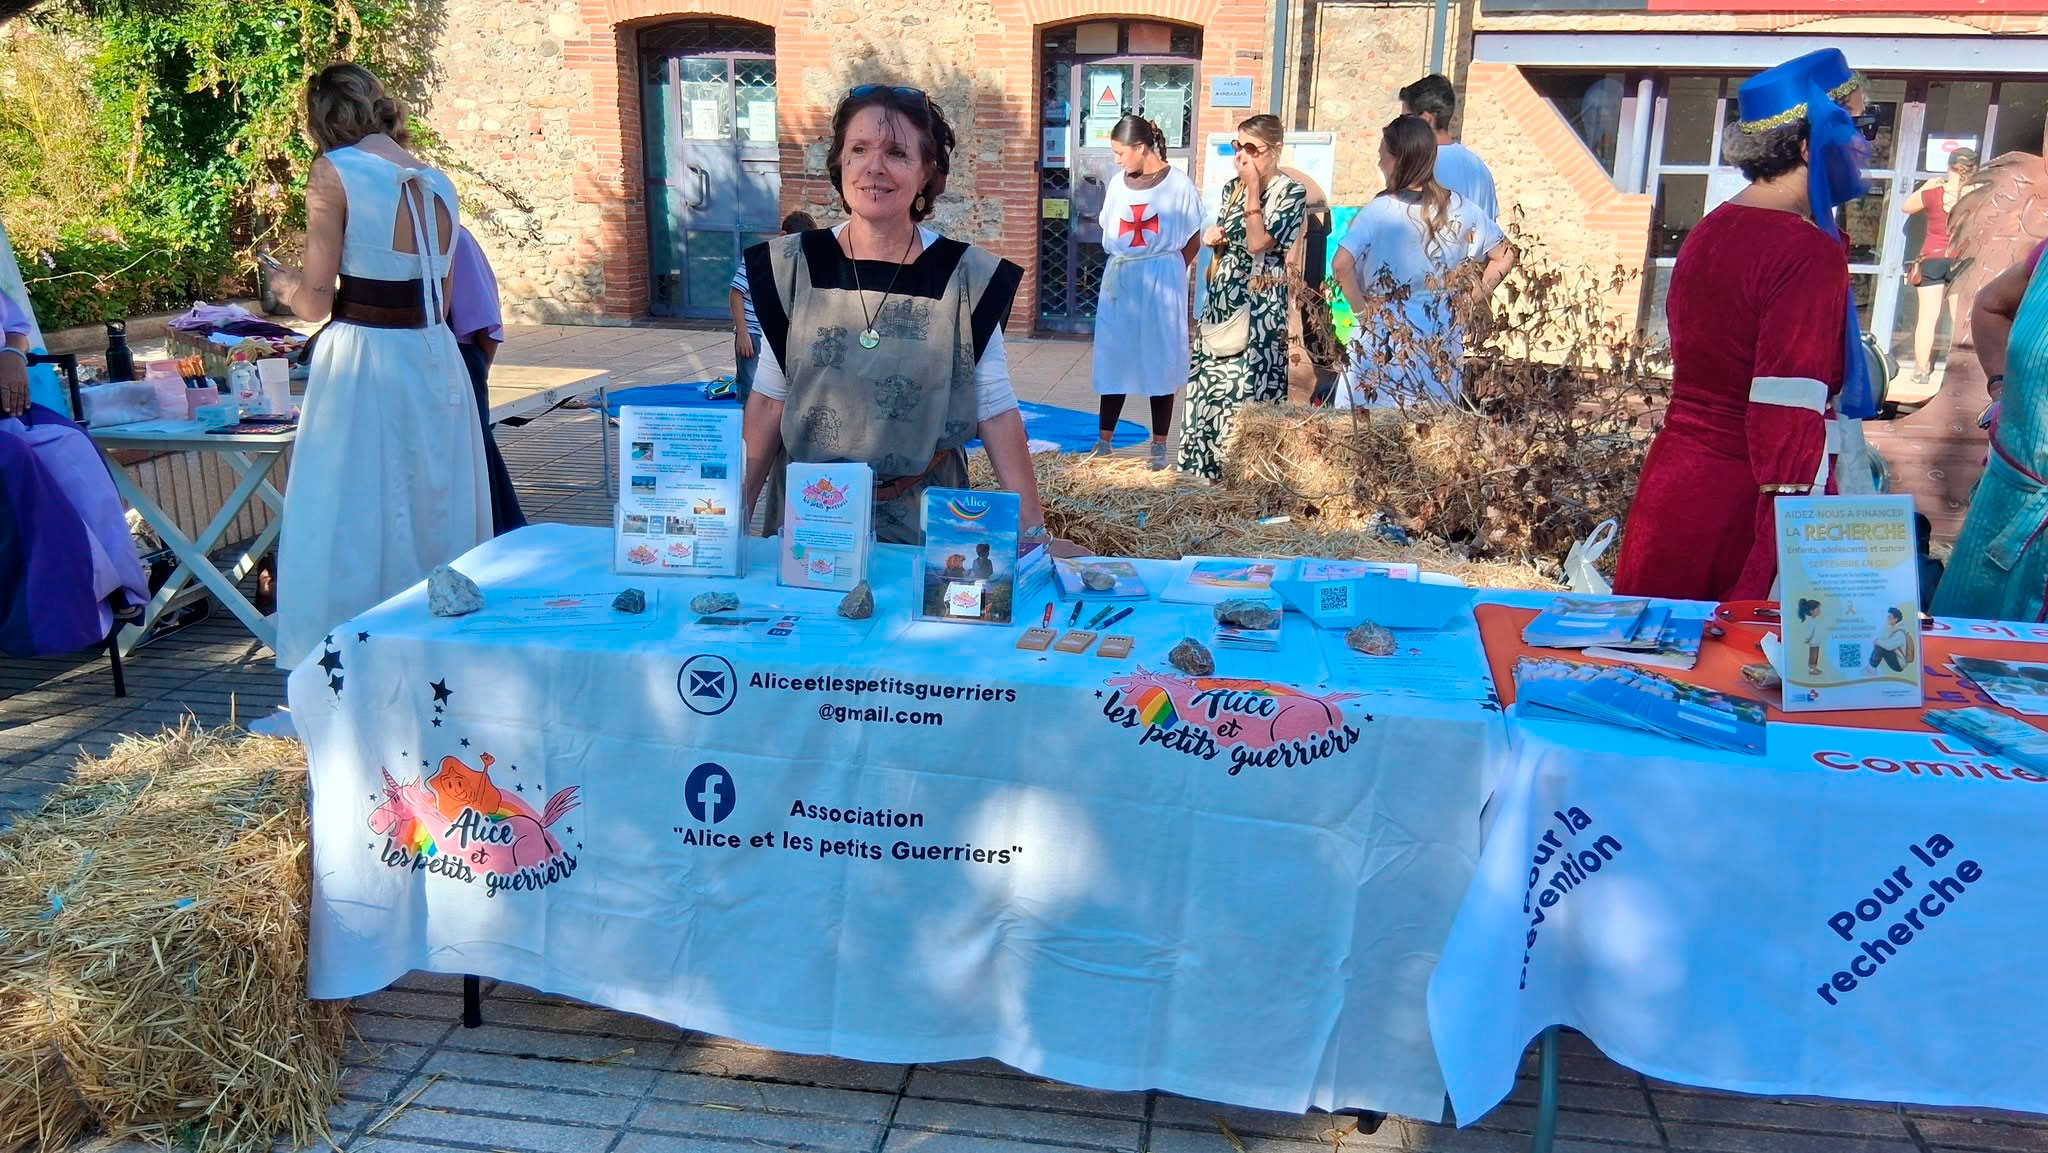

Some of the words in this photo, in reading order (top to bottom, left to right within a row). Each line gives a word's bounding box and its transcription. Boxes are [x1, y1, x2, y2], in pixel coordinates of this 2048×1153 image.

[962, 496, 987, 507] Alice
[1855, 508, 1904, 518] FINANCER
[1785, 527, 1801, 537] LA
[1804, 523, 1906, 541] RECHERCHE
[1821, 545, 1868, 553] adolescents
[749, 672, 1017, 703] Aliceetlespetitsguerriers
[818, 704, 943, 726] @gmail.com
[1191, 689, 1275, 719] Alice
[1103, 690, 1140, 728] les
[1139, 723, 1220, 760] petits
[1228, 724, 1360, 776] guerriers
[1217, 718, 1243, 738] et
[444, 807, 513, 849] Alice
[790, 799, 924, 828] Association
[471, 847, 491, 865] et
[673, 827, 741, 849] "Alice
[749, 831, 775, 848] et
[782, 831, 814, 852] les
[819, 836, 883, 861] petits
[890, 840, 1024, 865] Guerriers"
[1523, 829, 1563, 914] Pour
[1553, 806, 1592, 836] la
[381, 838, 412, 867] les
[411, 853, 476, 884] petits
[486, 851, 577, 898] guerriers
[1827, 865, 1913, 942] Pour
[1909, 833, 1955, 868] la
[1816, 860, 1983, 1006] recherche
